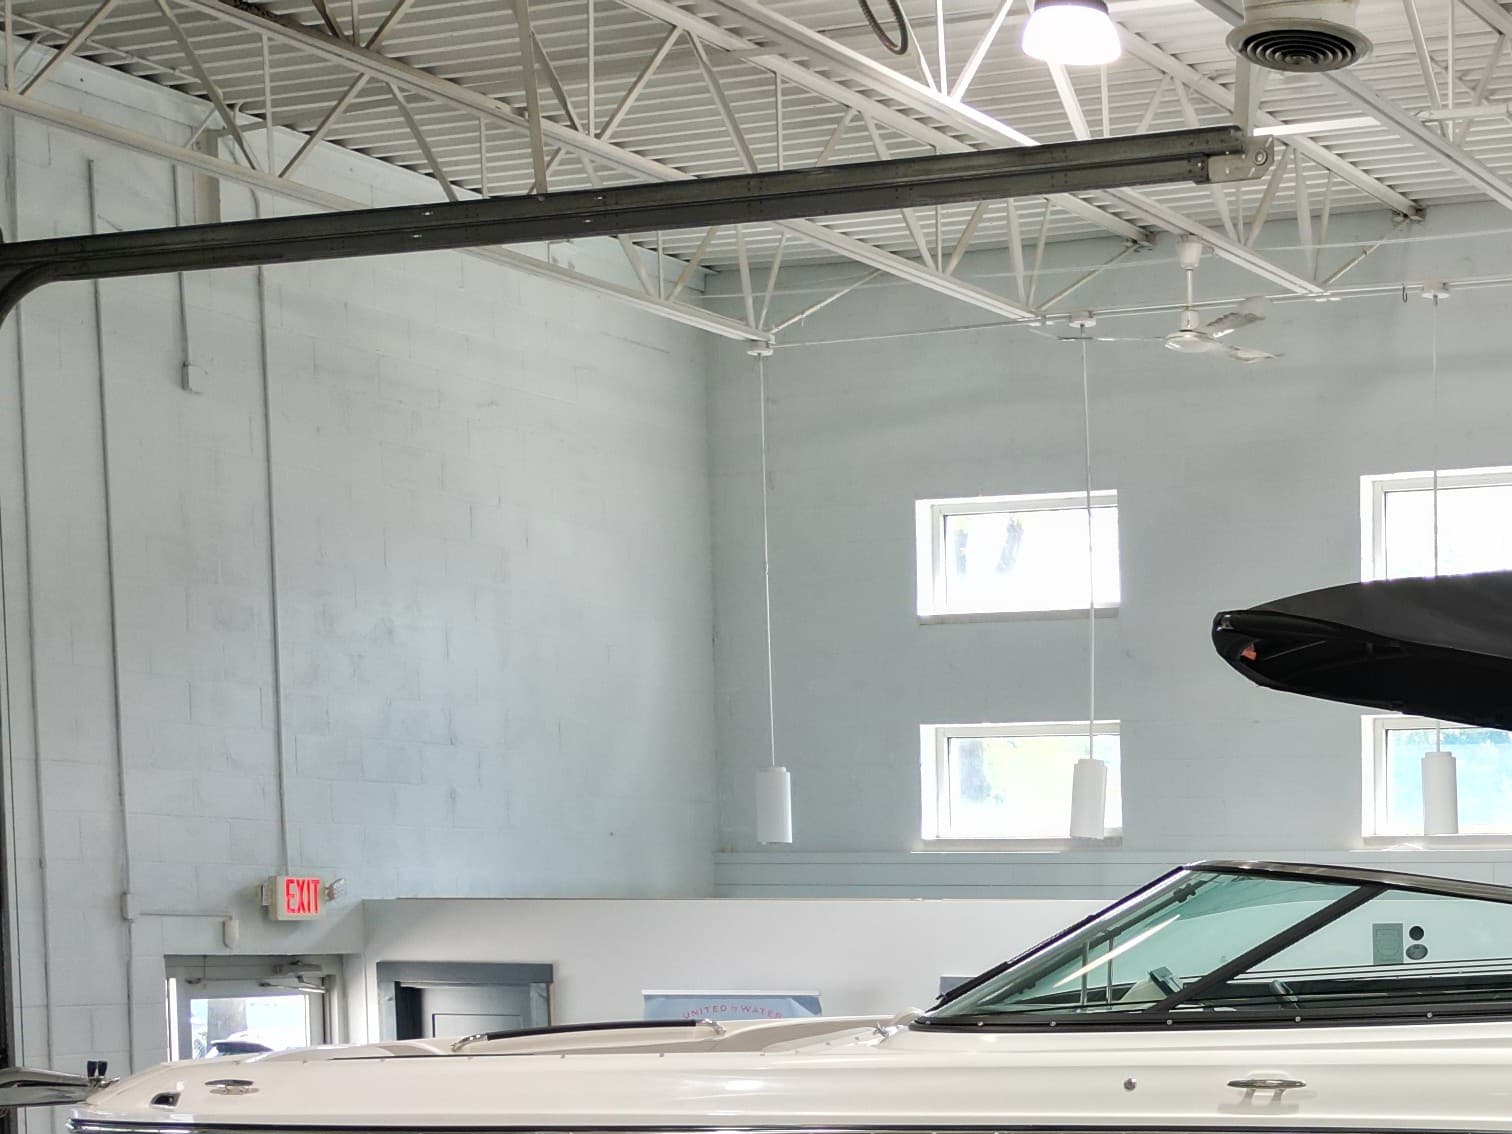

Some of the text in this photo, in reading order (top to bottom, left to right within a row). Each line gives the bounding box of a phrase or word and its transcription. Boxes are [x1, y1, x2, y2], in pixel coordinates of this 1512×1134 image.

[285, 879, 320, 913] EXIT
[682, 1004, 728, 1019] UNITED
[740, 1004, 783, 1019] WATER
